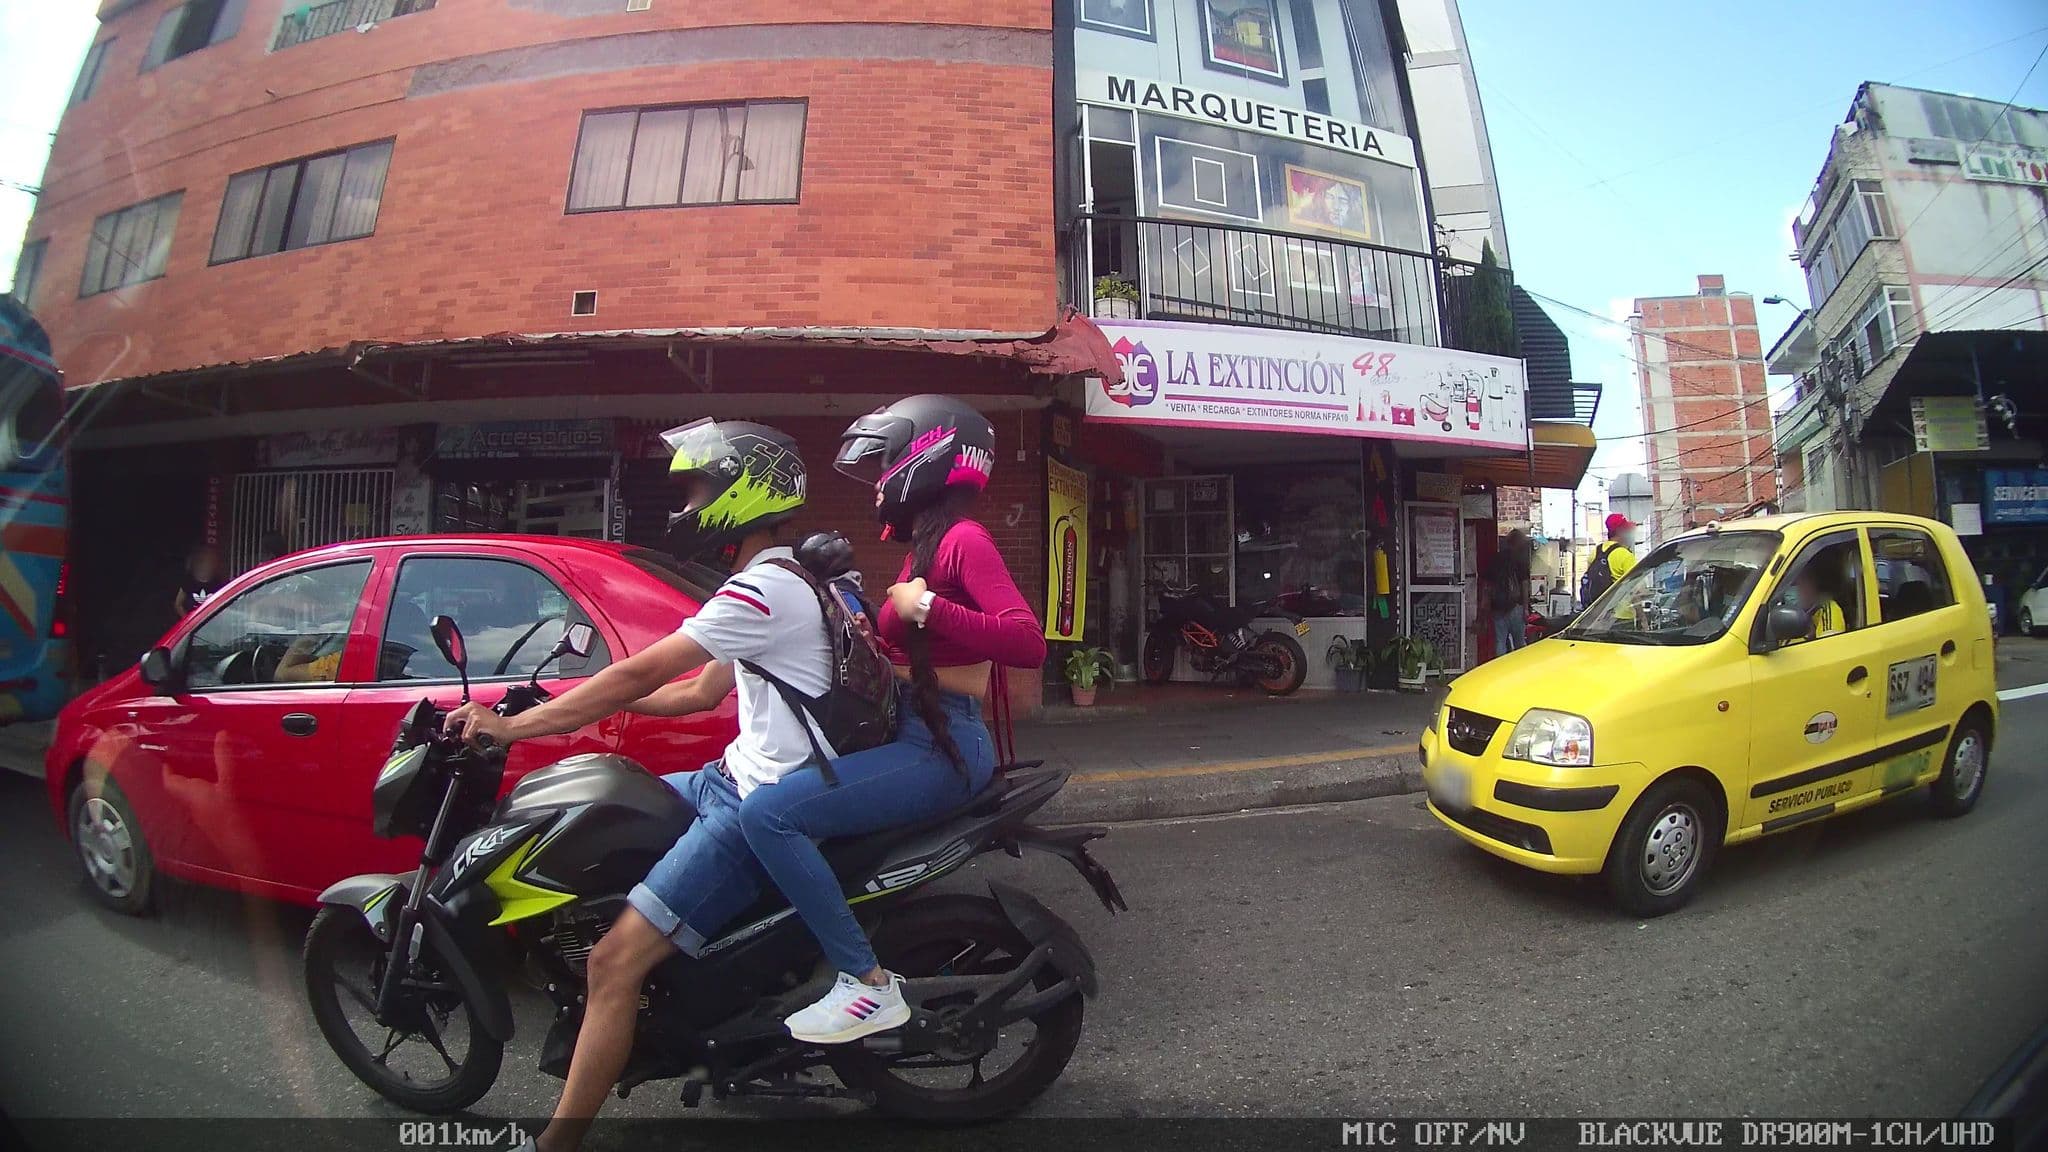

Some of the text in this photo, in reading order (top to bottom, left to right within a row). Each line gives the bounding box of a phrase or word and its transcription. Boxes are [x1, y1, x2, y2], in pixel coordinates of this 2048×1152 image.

[1108, 76, 1384, 156] MARQUETERIA
[1165, 350, 1347, 396] LA EXTINCIÓN
[1352, 351, 1397, 377] 48
[1171, 404, 1349, 422] VENTA RECARGA EXTINTORES NORMA NFPA10
[1769, 790, 1814, 814] SERVICIO
[864, 838, 971, 893] 125
